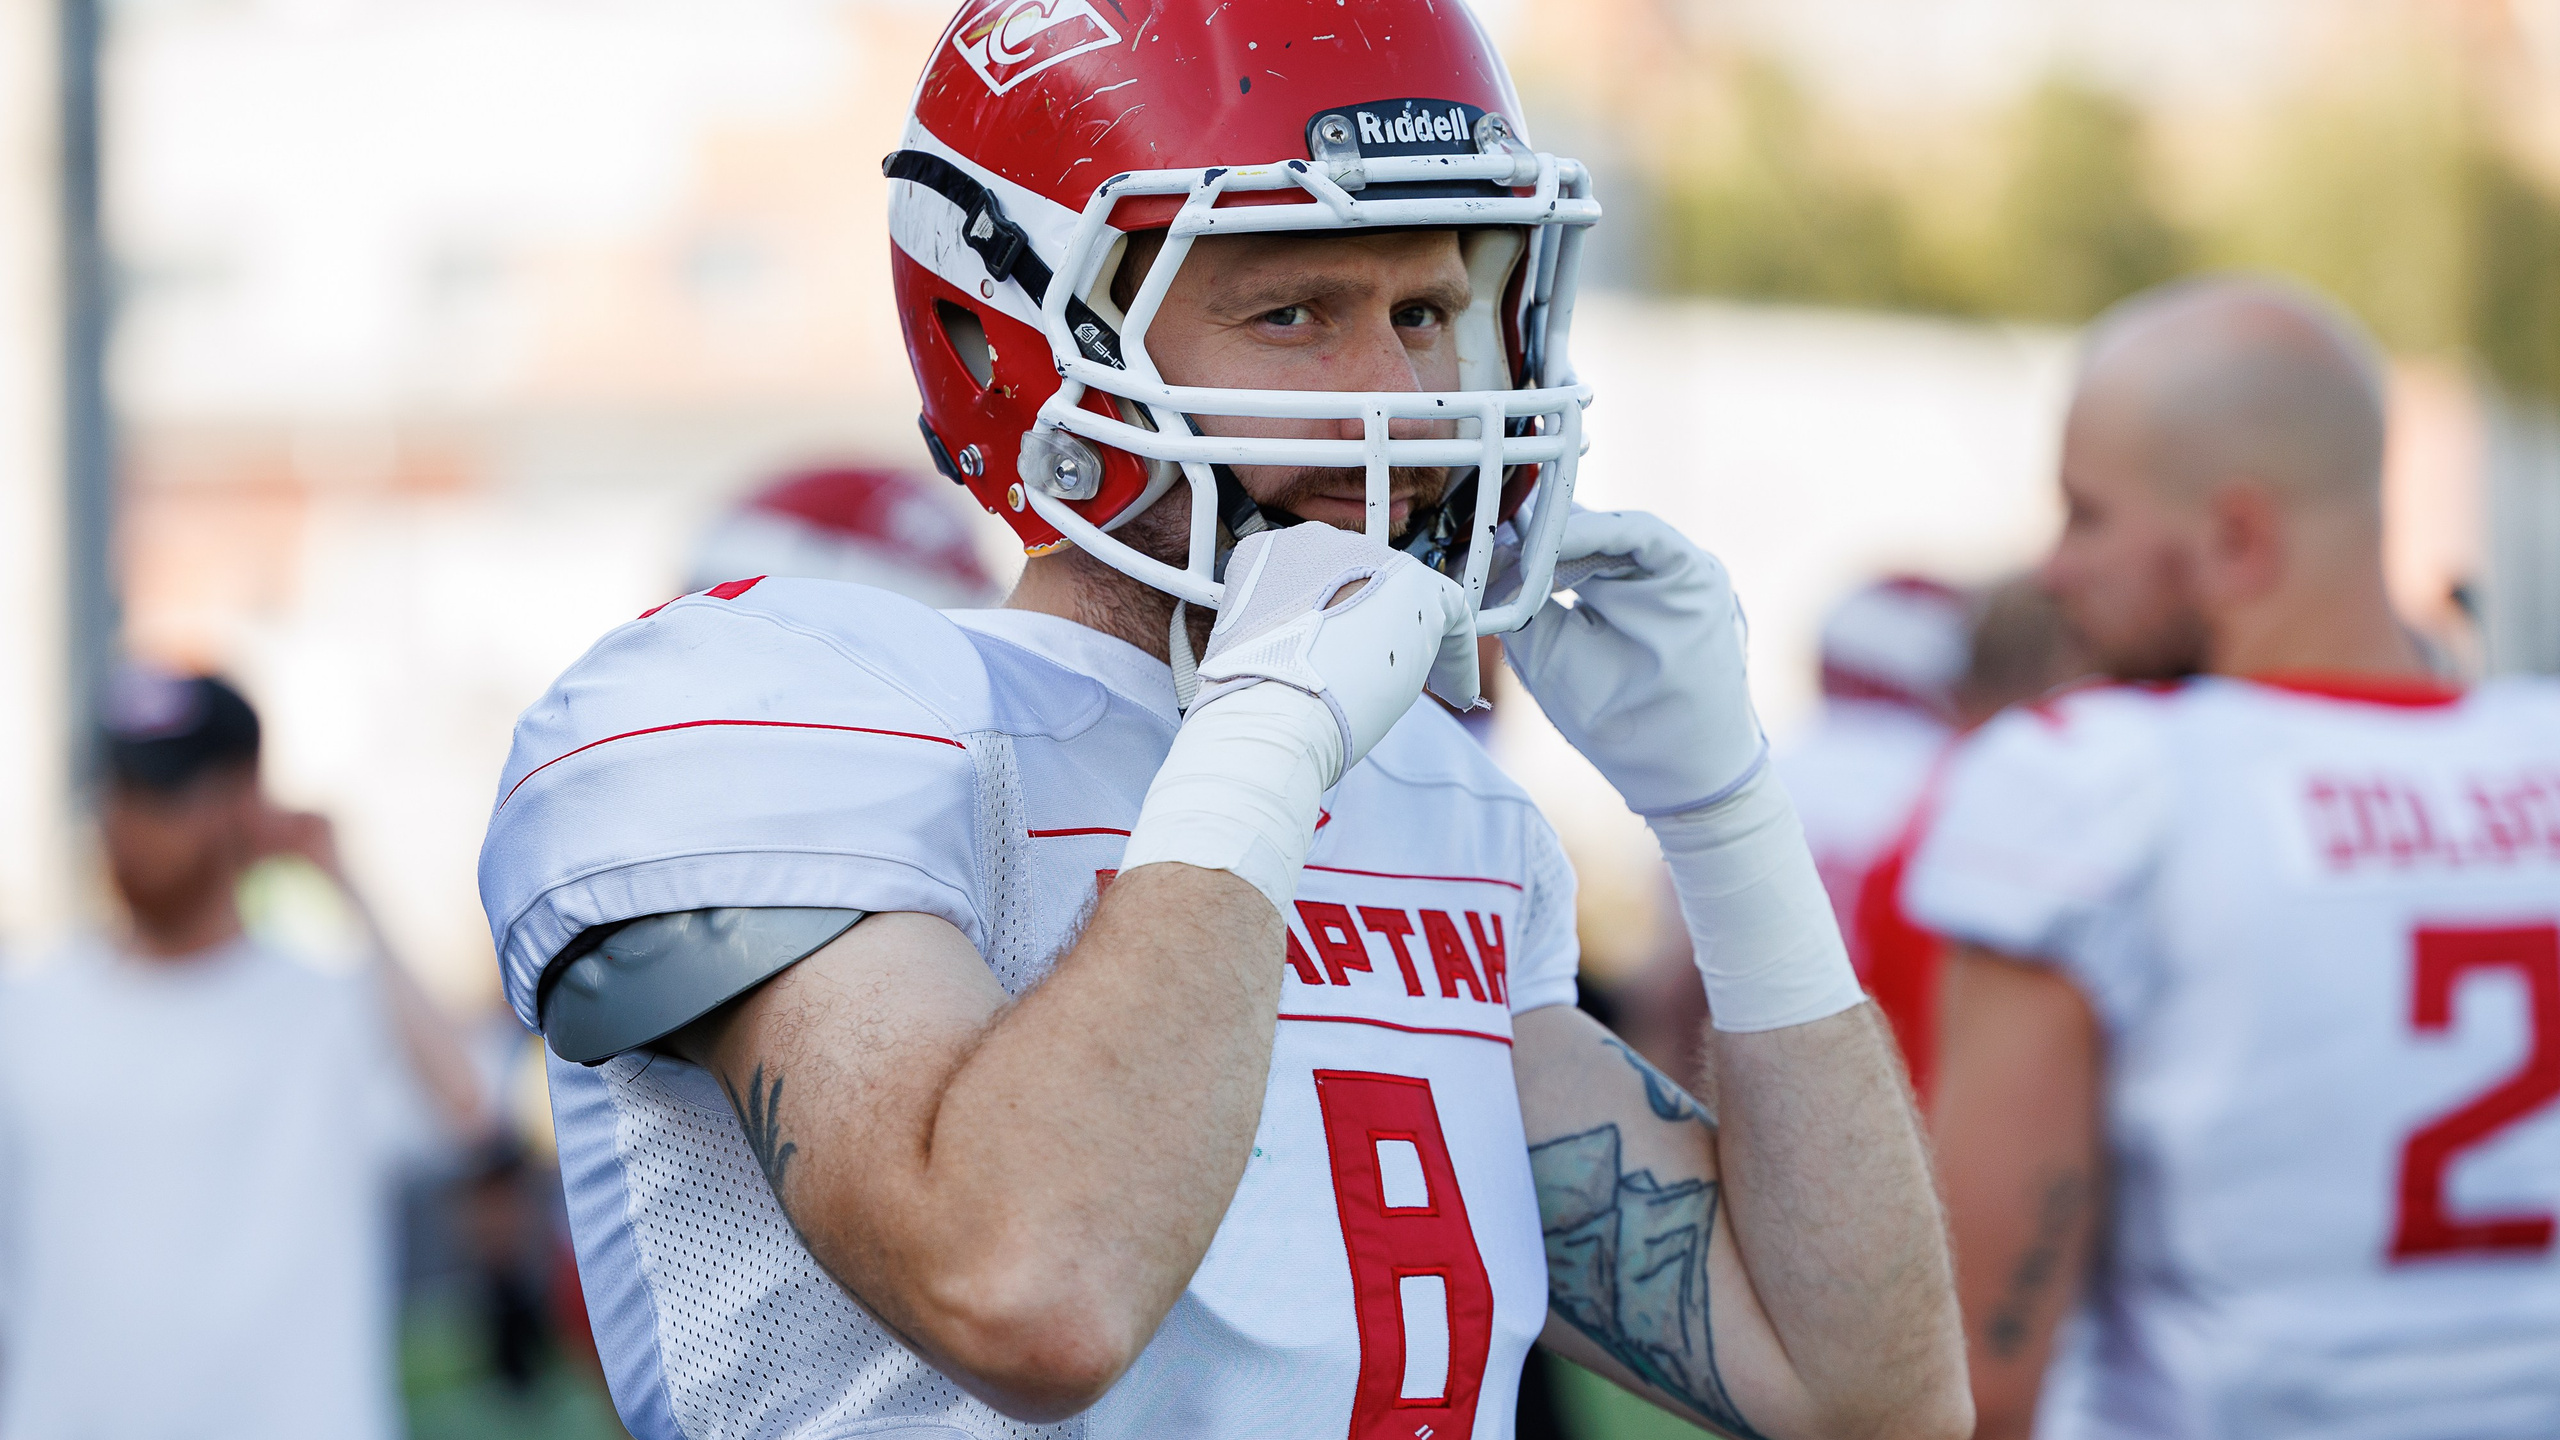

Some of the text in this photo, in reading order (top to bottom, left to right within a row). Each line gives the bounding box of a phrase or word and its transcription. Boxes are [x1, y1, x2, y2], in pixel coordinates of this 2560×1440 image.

[1356, 103, 1470, 145] Riddell
[1312, 1068, 1494, 1440] 8
[2386, 925, 2560, 1266] 2
